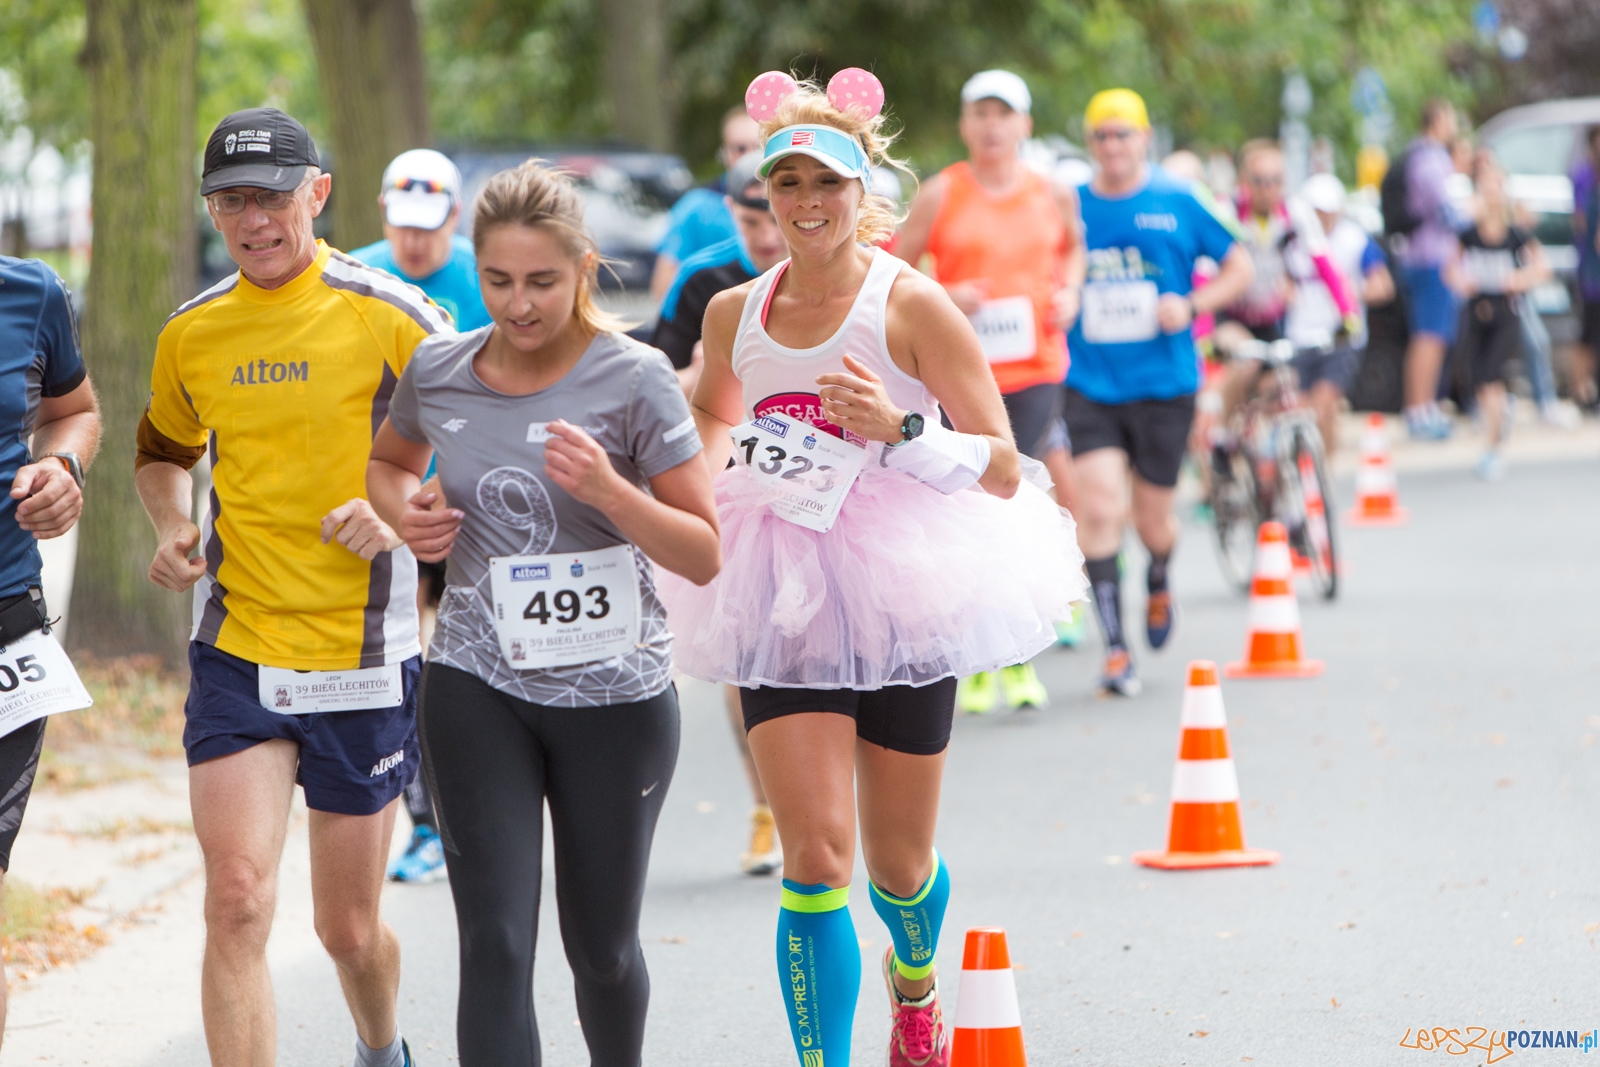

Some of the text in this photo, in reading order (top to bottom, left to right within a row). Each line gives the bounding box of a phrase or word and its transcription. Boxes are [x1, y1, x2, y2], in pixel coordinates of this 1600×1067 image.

[441, 418, 468, 433] 4F
[740, 436, 837, 493] 1323
[476, 466, 558, 556] 9
[523, 585, 610, 625] 493
[529, 637, 543, 648] 39
[546, 635, 573, 646] BIEG
[4, 690, 27, 702] TOMASZ
[295, 677, 391, 694] 39 BIEG LECHITÓW
[0, 697, 23, 716] BIEG
[808, 935, 816, 967] TECHNOLOGY
[810, 967, 818, 1003] COMPRESSION
